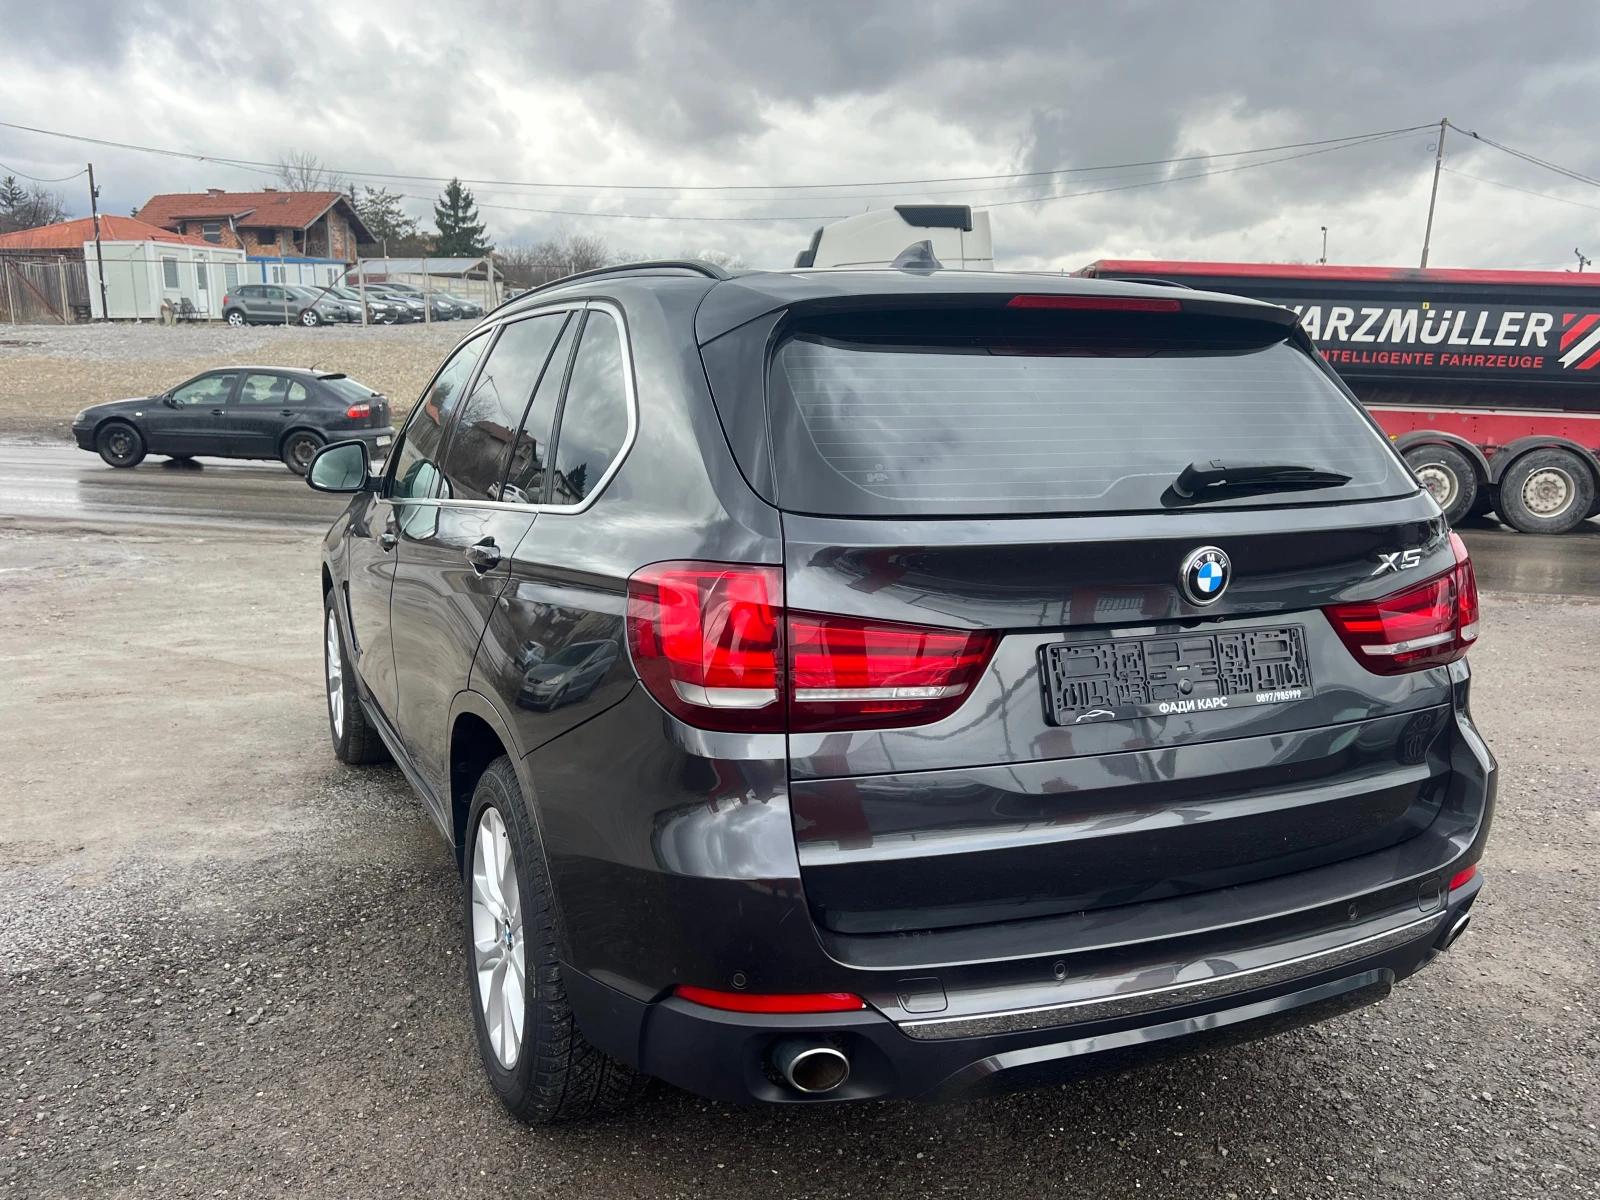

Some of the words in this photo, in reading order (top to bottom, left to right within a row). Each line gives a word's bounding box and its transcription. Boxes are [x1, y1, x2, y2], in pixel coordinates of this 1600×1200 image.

[1278, 304, 1554, 347] ARZMÜLLER
[1440, 353, 1544, 369] FAHRZEUGE
[1193, 553, 1227, 570] BMW
[1371, 548, 1422, 576] X5
[1256, 689, 1302, 703] 0897/985999
[1158, 699, 1196, 714] ФАДИ
[1197, 696, 1229, 710] КАРС
